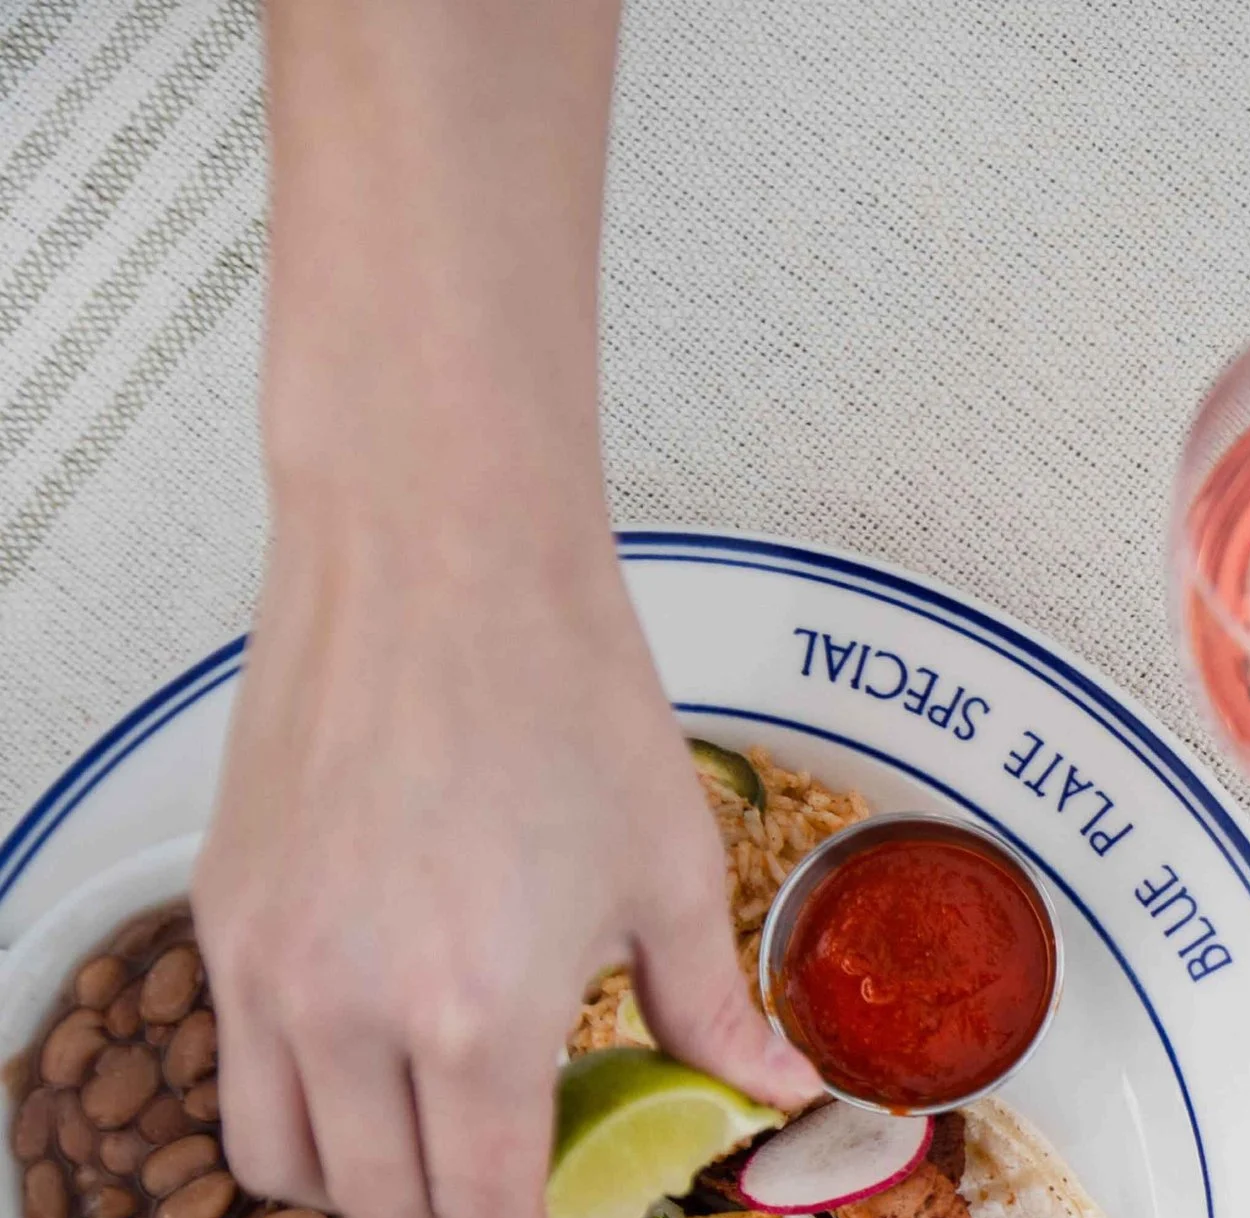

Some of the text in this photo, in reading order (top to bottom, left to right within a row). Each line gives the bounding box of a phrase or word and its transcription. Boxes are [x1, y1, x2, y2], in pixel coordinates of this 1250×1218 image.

[793, 627, 1234, 983] BLUE PLATE SPECIAL
